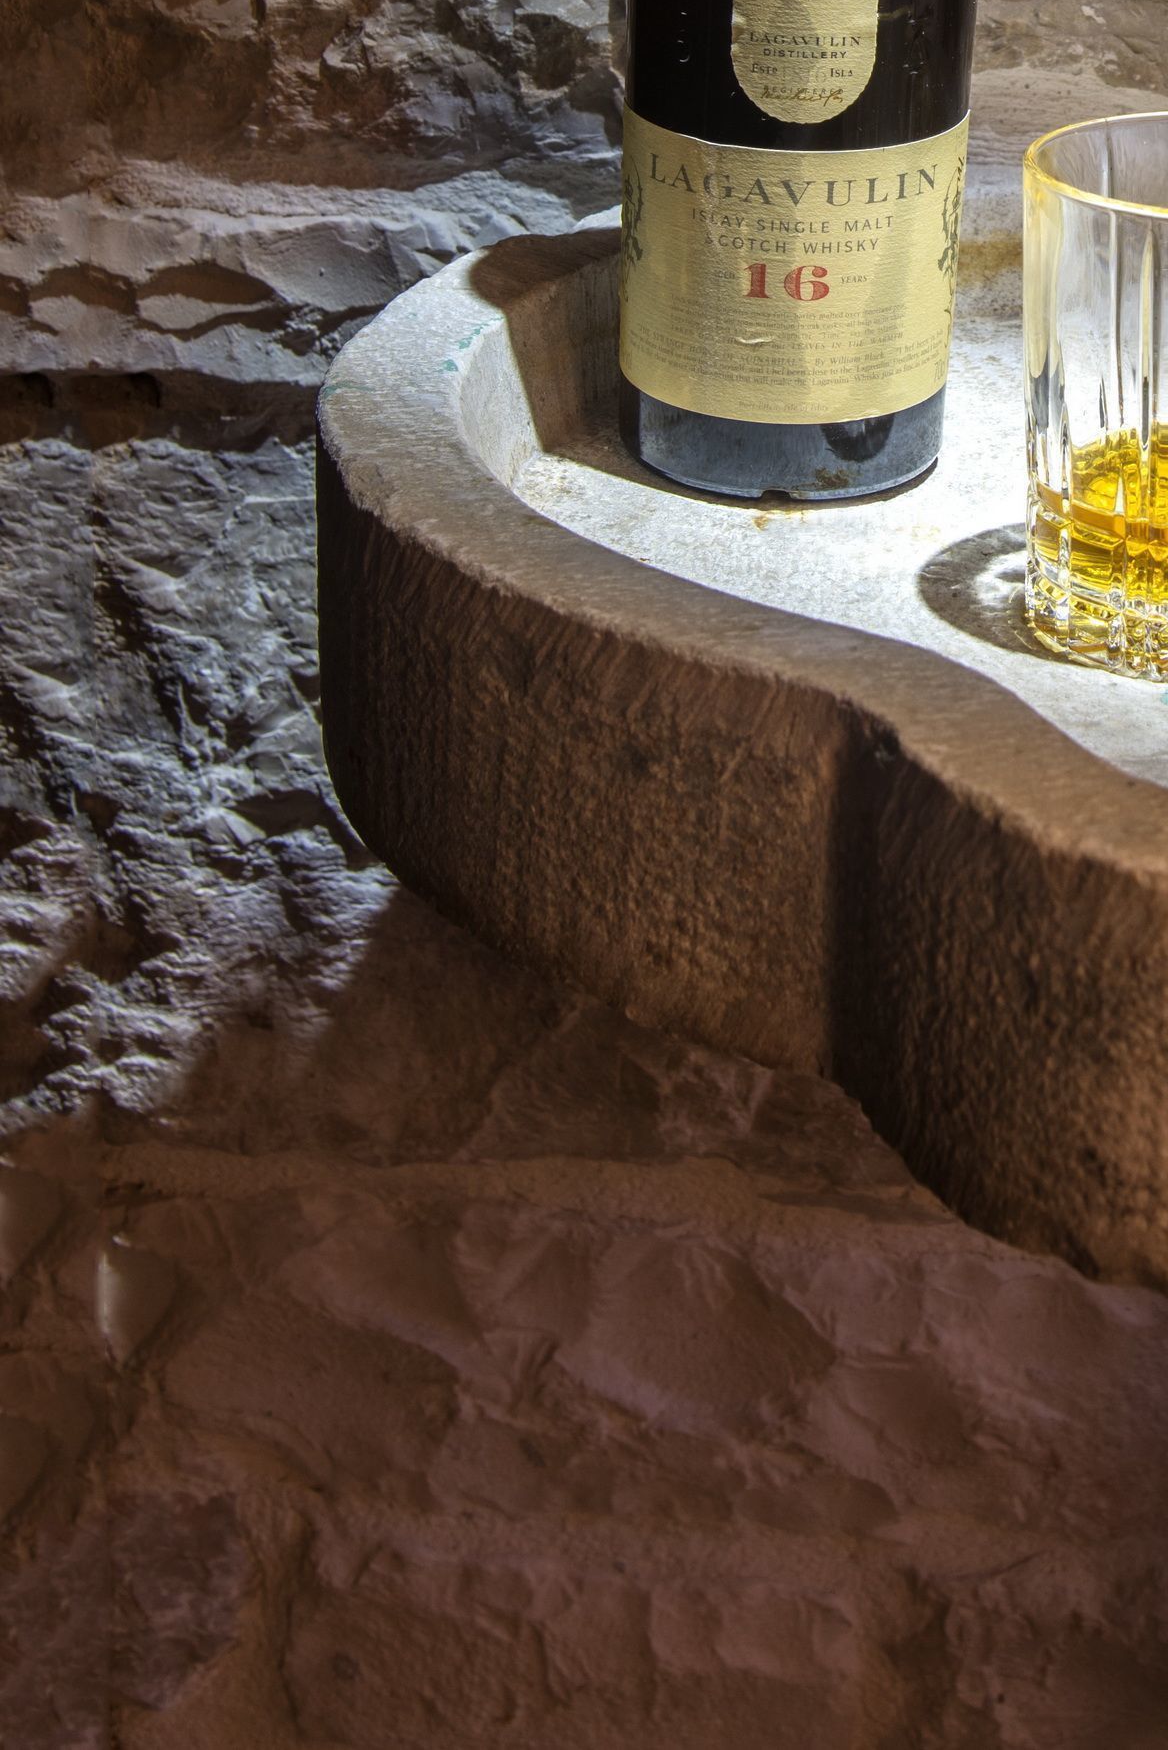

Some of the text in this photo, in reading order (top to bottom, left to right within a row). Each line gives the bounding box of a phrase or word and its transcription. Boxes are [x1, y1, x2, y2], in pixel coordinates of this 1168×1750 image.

[750, 32, 861, 47] LAGAVULIN
[763, 48, 847, 59] DISTILLERY
[649, 152, 939, 207] LAGAVULIN
[691, 208, 894, 234] ISLAY SINGLE MALT
[703, 232, 880, 255] SCOTCH WHISKY
[743, 262, 830, 301] 16
[840, 274, 868, 285] YEARS
